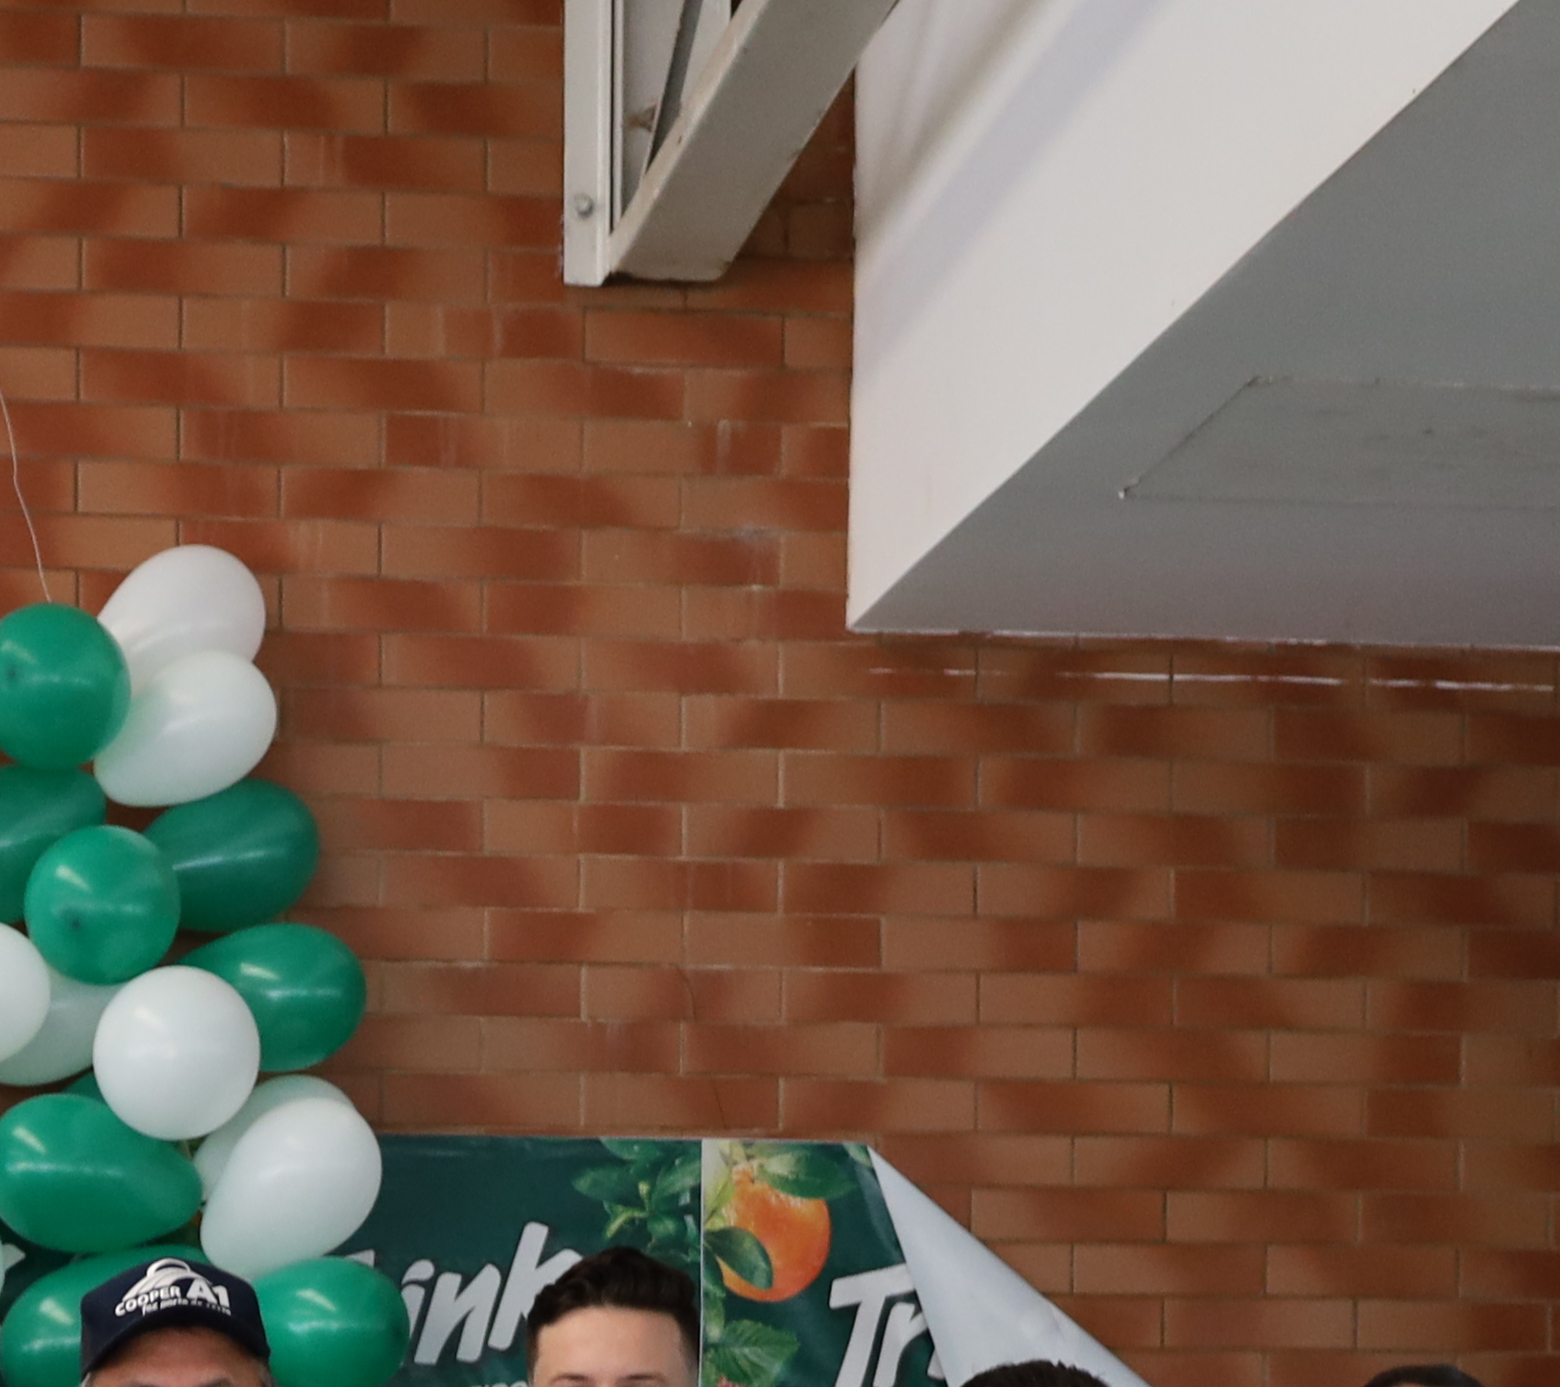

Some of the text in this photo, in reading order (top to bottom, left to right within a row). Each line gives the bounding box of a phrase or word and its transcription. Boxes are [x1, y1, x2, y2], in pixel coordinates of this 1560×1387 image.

[115, 1285, 180, 1317] COOPER
[187, 1279, 230, 1309] A1
[370, 1222, 583, 1366] ink
